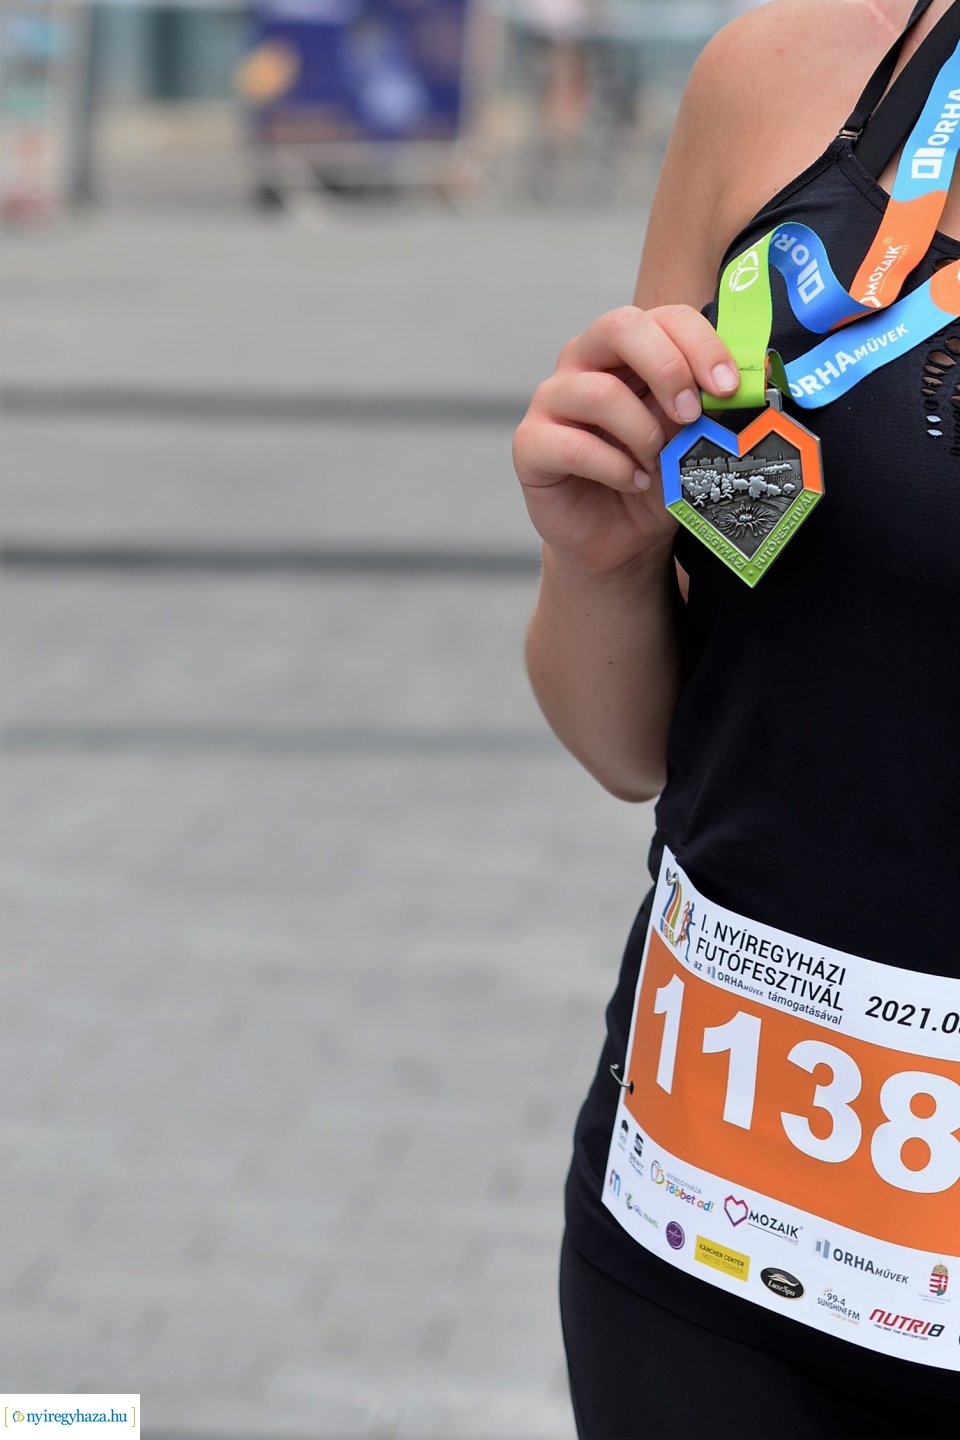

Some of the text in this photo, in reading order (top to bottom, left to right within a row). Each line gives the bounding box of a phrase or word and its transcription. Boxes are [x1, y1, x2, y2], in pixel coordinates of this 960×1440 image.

[864, 245, 902, 296] MOZAIK
[696, 936, 845, 1012] FUTÓFESZTIVÁL
[701, 914, 847, 986] I. NYÍREGYHÁZI
[693, 961, 702, 972] az
[767, 990, 842, 1026] támogatásával
[748, 1210, 800, 1240] MOZAIK
